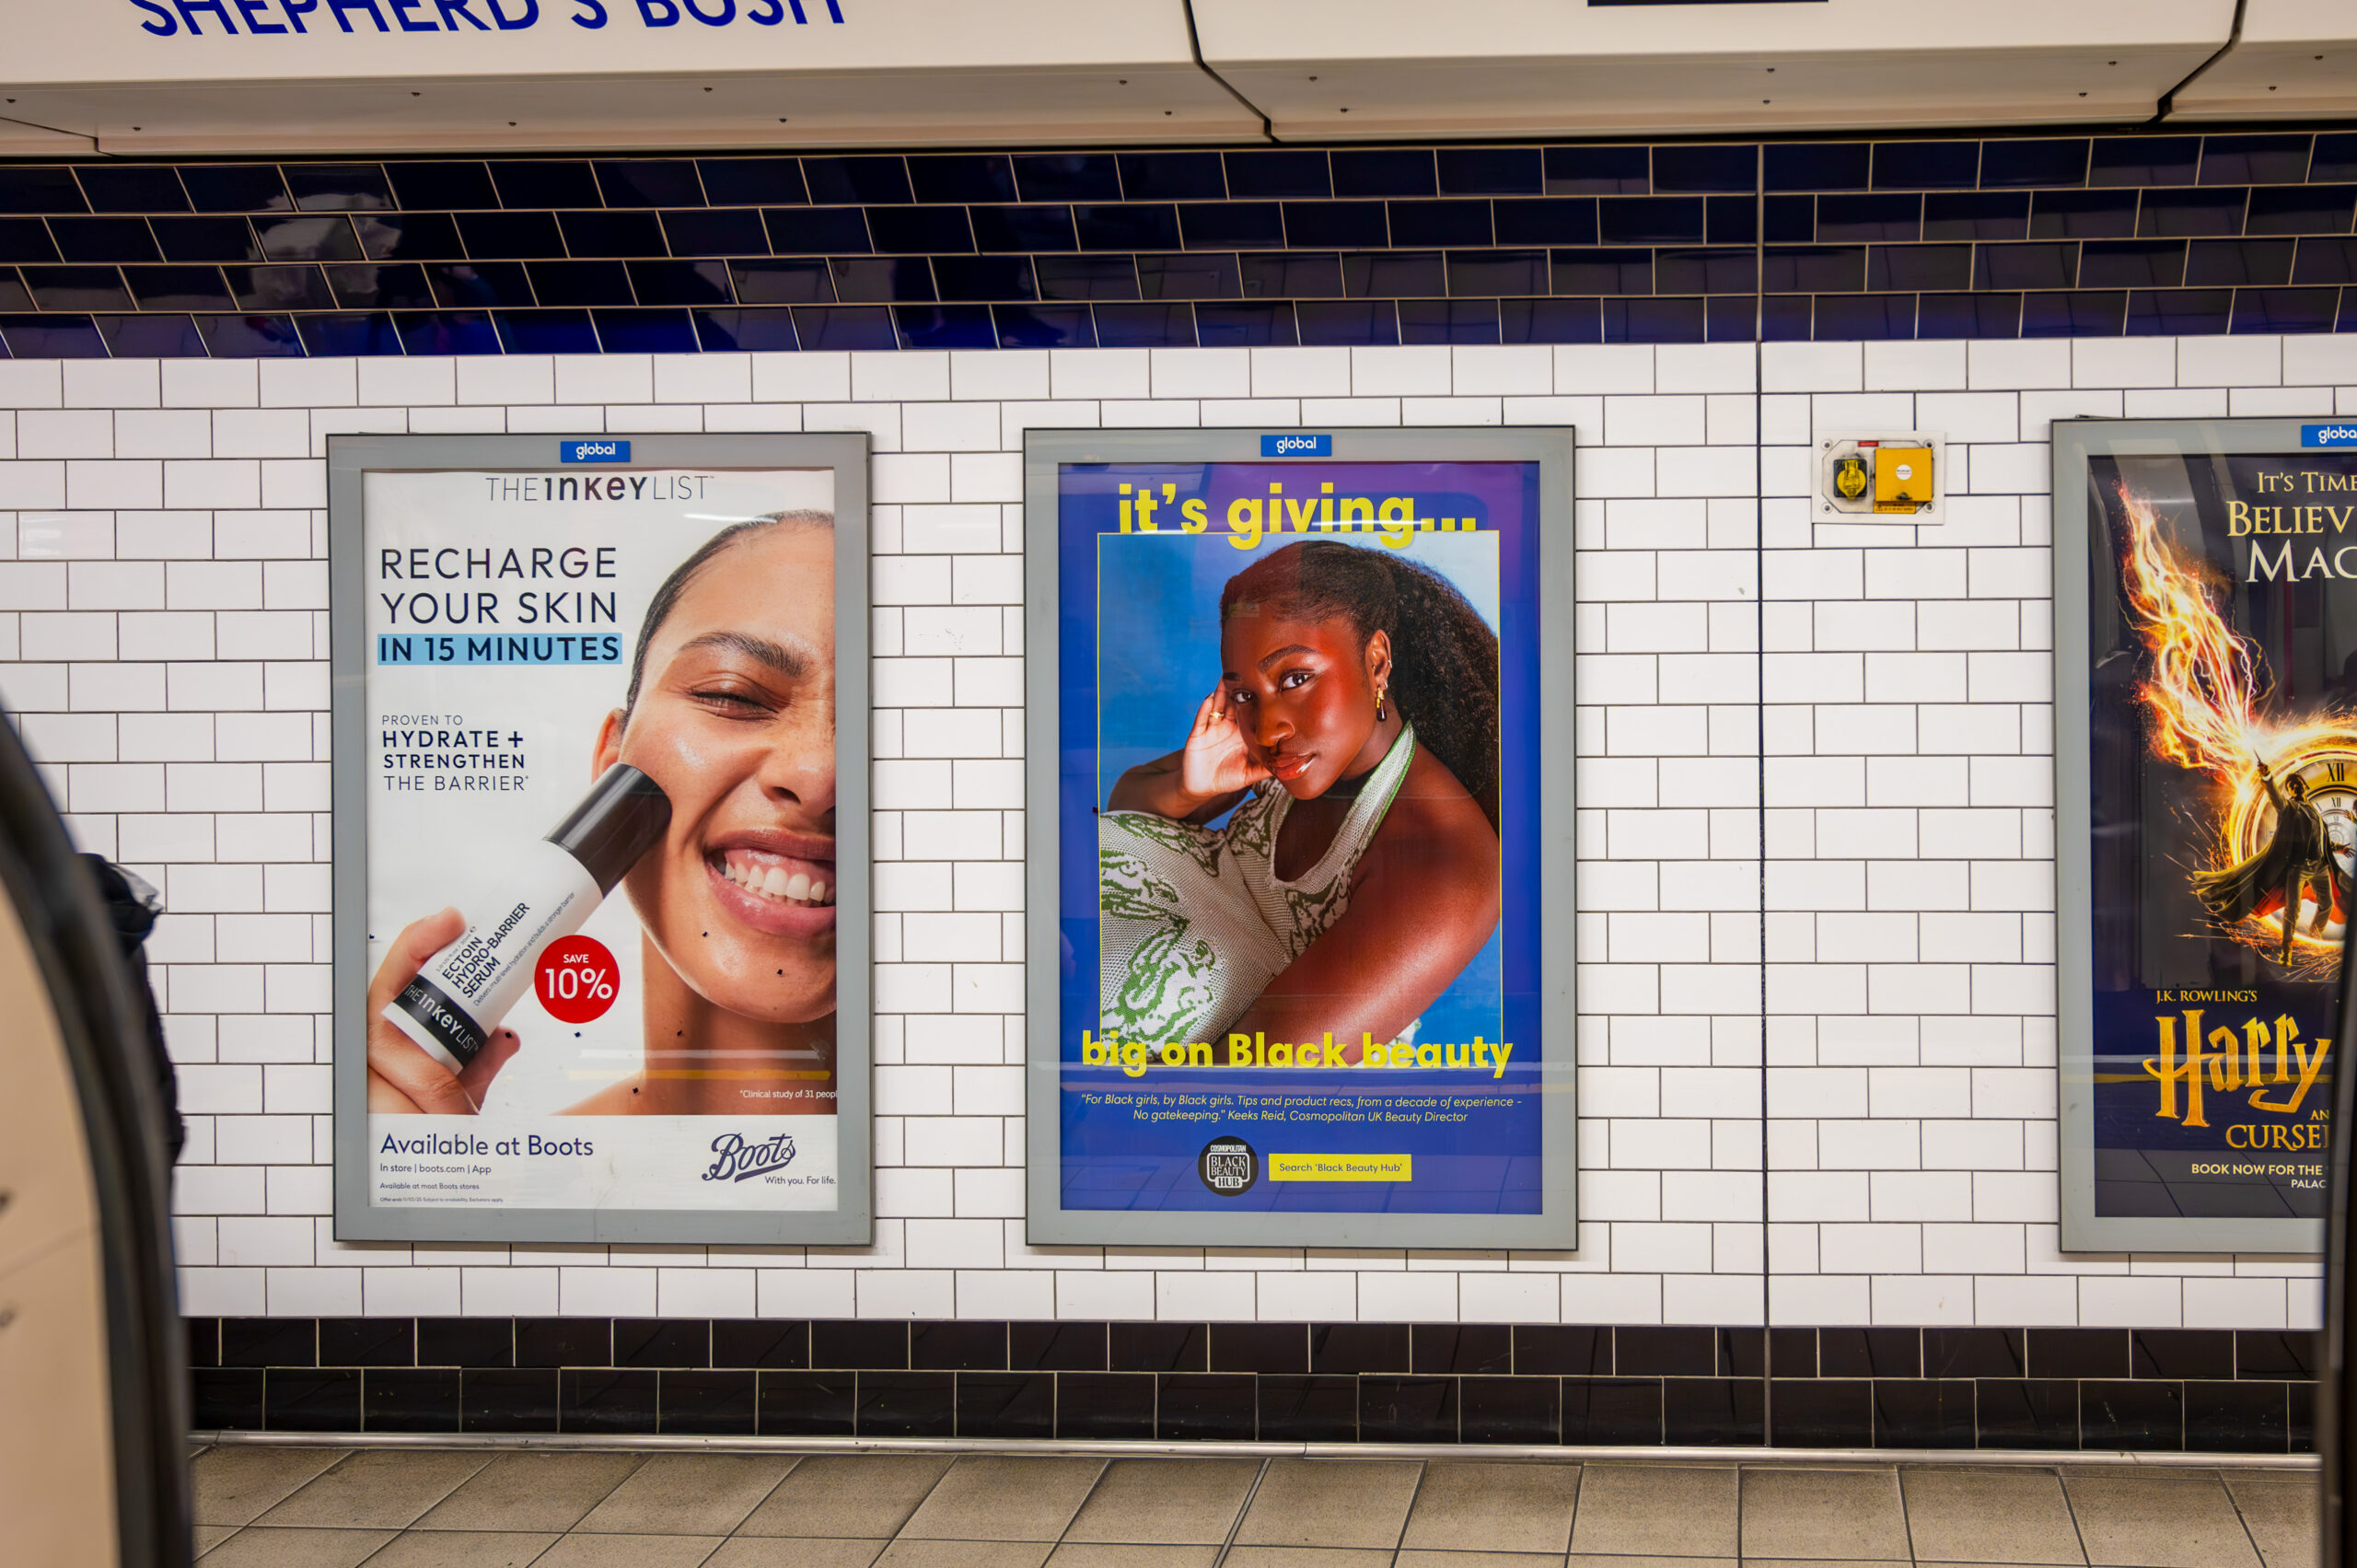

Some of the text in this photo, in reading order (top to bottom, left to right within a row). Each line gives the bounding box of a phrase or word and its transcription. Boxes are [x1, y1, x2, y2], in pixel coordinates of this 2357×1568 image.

[130, 0, 609, 37] SHEPHERDS
[575, 443, 617, 459] global
[1276, 436, 1318, 454] global
[2257, 471, 2294, 493] IT'S
[1118, 482, 1477, 551] it's giving...
[380, 547, 618, 580] RECHARGE
[380, 591, 618, 625] YOUR SKIN
[380, 636, 620, 662] IN 15 MINUTES
[382, 714, 463, 726] PROVEN TO
[383, 730, 523, 748] HYDRATE +
[383, 754, 525, 769] STRENGTHEN
[2327, 762, 2345, 782] XII
[383, 775, 424, 791] THE
[452, 902, 530, 989] HYDRO-BARRIER
[442, 936, 483, 981] ECTOIN
[563, 954, 589, 964] SAVE
[462, 957, 501, 999] SERUM
[545, 968, 613, 1000] 10%
[2156, 990, 2258, 1005] J.K. ROWLING'S
[1081, 1030, 1514, 1079] big on Black beauty
[2142, 1009, 2332, 1128] Harry
[772, 1090, 794, 1100] study
[795, 1089, 804, 1098] of
[805, 1090, 814, 1098] 31
[1105, 1094, 1133, 1105] Black
[1135, 1094, 1161, 1108] girls,
[1163, 1095, 1177, 1108] by
[1178, 1095, 1207, 1105] Black
[1209, 1095, 1235, 1108] girls.
[1237, 1095, 1258, 1108] Tips
[1260, 1095, 1283, 1106] and
[1283, 1096, 1327, 1109] product
[1329, 1097, 1354, 1108] recs,
[1355, 1096, 1382, 1109] from
[1385, 1098, 1392, 1107] a
[1395, 1096, 1437, 1107] decade
[1440, 1096, 1452, 1109] of
[1453, 1097, 1514, 1109] experience
[1133, 1109, 1149, 1120] No
[1227, 1110, 1259, 1121] Keeks
[1261, 1110, 1287, 1122] Reid,
[1289, 1110, 1365, 1123] Cosmopolitan
[1367, 1111, 1383, 1121] UK
[1385, 1111, 1422, 1124] Beauty
[1424, 1111, 1468, 1122] Director
[379, 1132, 594, 1156] Available at Boots
[1210, 1144, 1247, 1153] COSMOPOLITAN
[702, 1132, 796, 1183] Boots
[1211, 1156, 1246, 1167] BLACK
[379, 1163, 389, 1172] In
[390, 1164, 412, 1173] store
[419, 1164, 465, 1174] boots.com
[472, 1165, 492, 1176] App
[1211, 1166, 1246, 1177] BEAUTY
[1279, 1163, 1313, 1172] Search
[1346, 1164, 1378, 1174] Beauty
[2191, 1164, 2323, 1176] BOOK NOW FOR THE
[764, 1176, 837, 1187] With you. For life.
[1218, 1177, 1240, 1187] HUB
